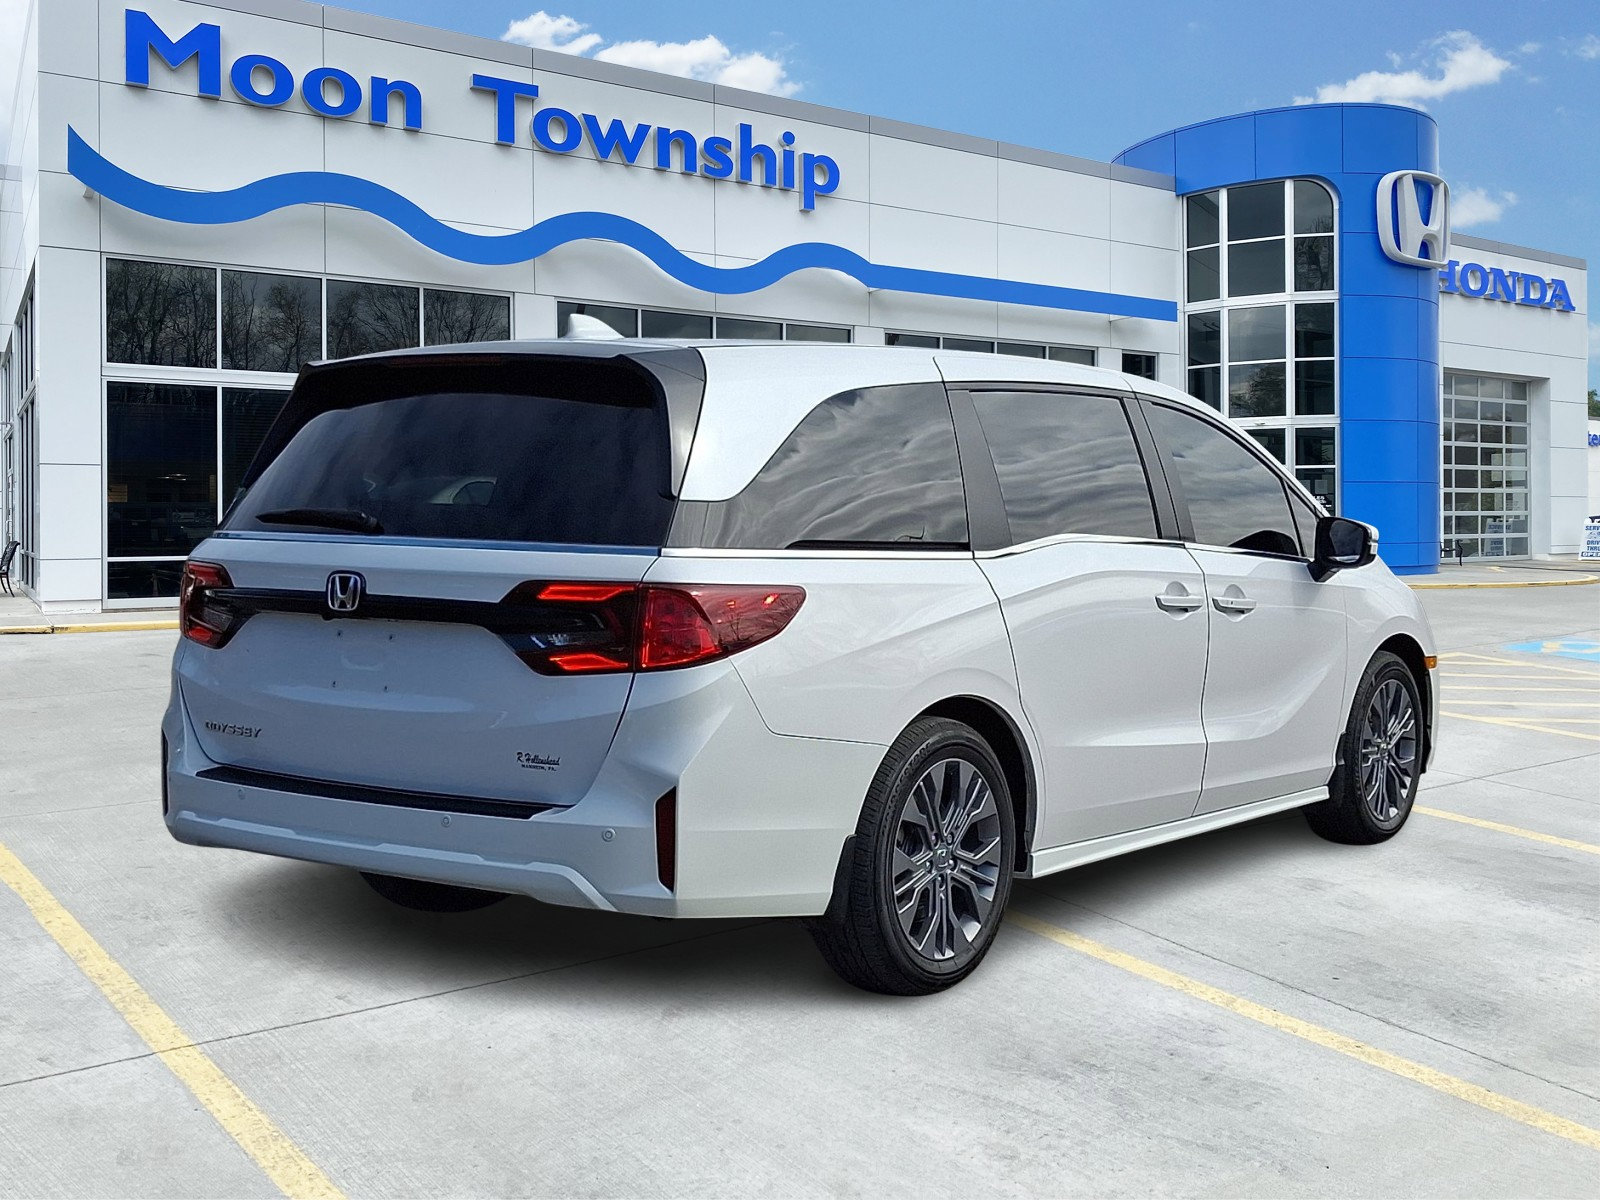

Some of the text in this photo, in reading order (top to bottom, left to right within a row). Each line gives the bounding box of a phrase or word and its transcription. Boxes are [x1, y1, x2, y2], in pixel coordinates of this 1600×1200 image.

[125, 9, 841, 212] Moon Township
[205, 720, 262, 738] ODYSSEY
